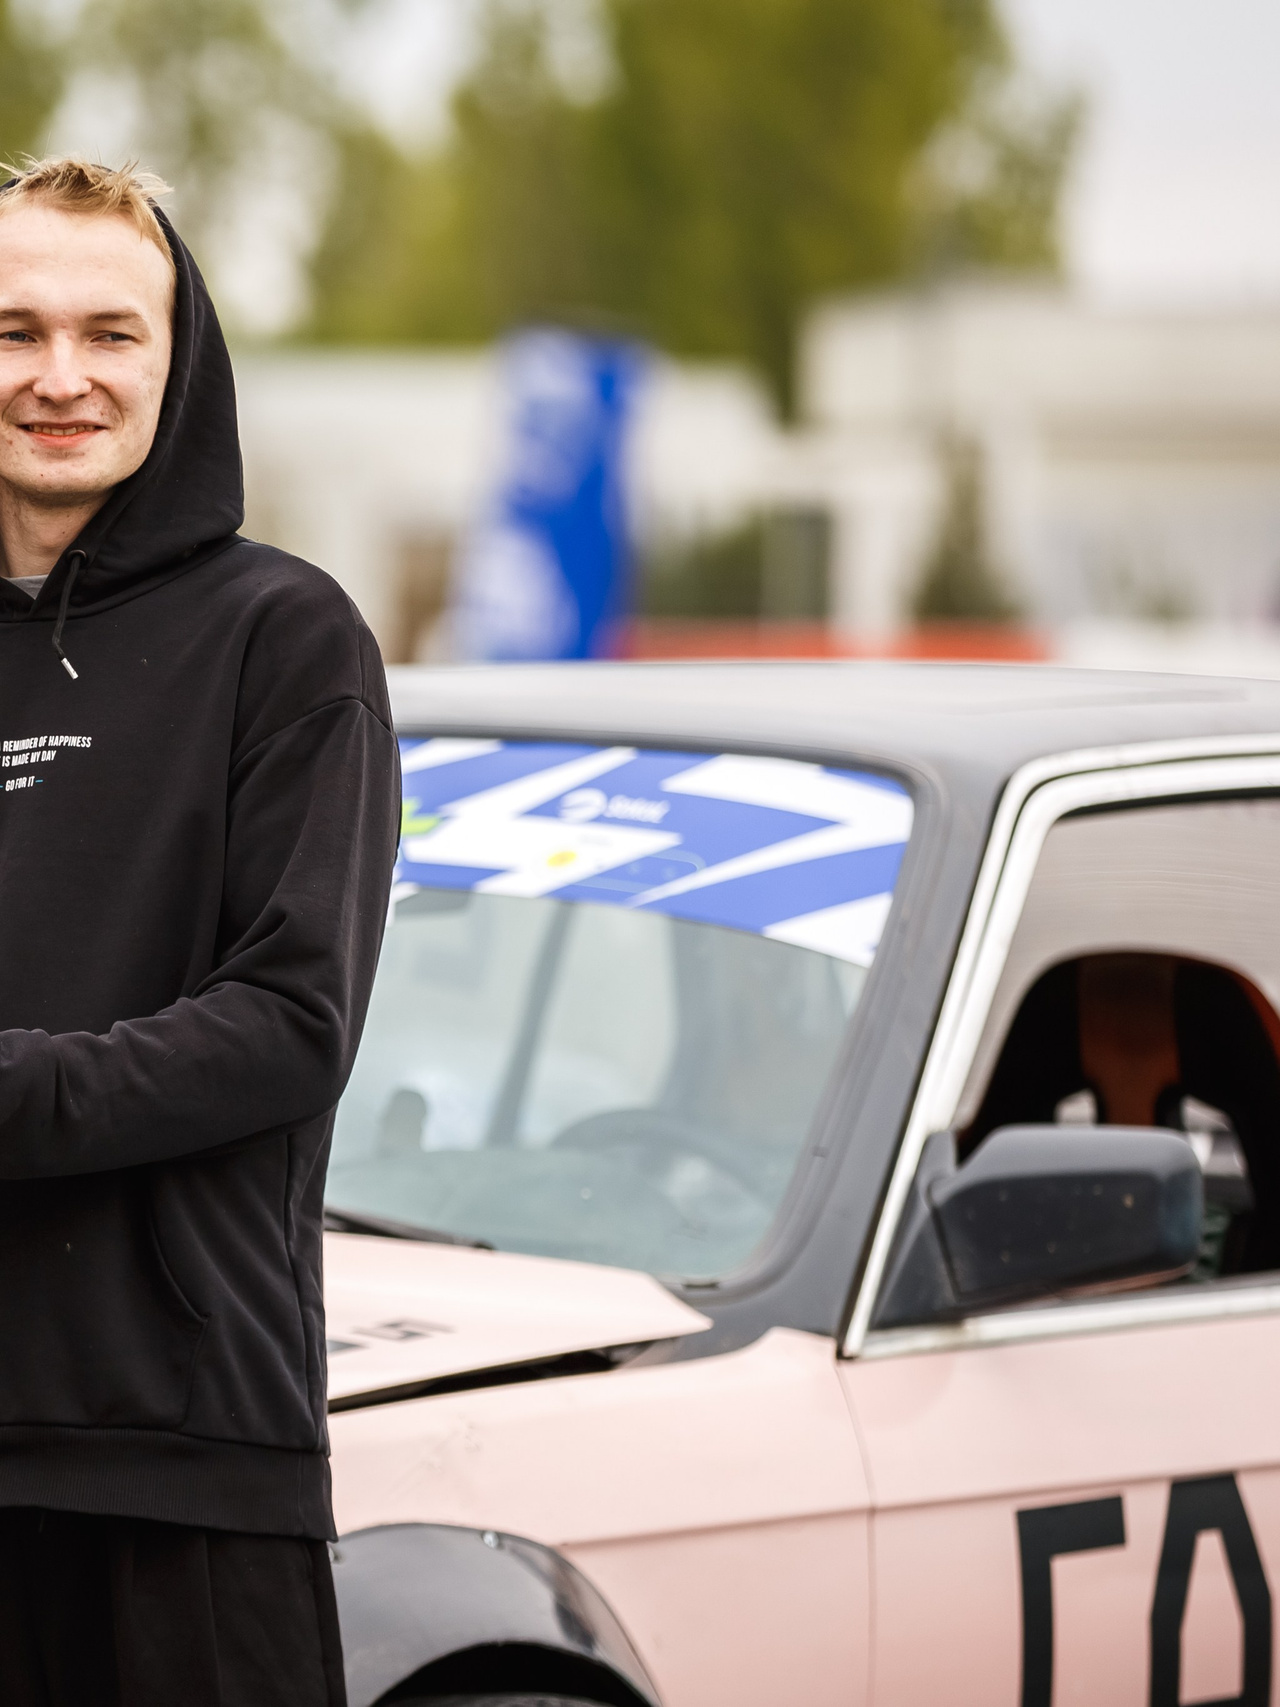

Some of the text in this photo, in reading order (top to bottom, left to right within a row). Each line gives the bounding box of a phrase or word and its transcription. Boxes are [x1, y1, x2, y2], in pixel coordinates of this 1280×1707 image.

[3, 738, 38, 752] REMINDER
[39, 736, 48, 747] OF
[48, 736, 92, 748] HAPPINESS
[2, 755, 10, 767] IS
[12, 753, 30, 766] MADE
[30, 751, 41, 763] MY
[41, 750, 56, 761] DAY
[5, 776, 35, 791] GO FOR IT
